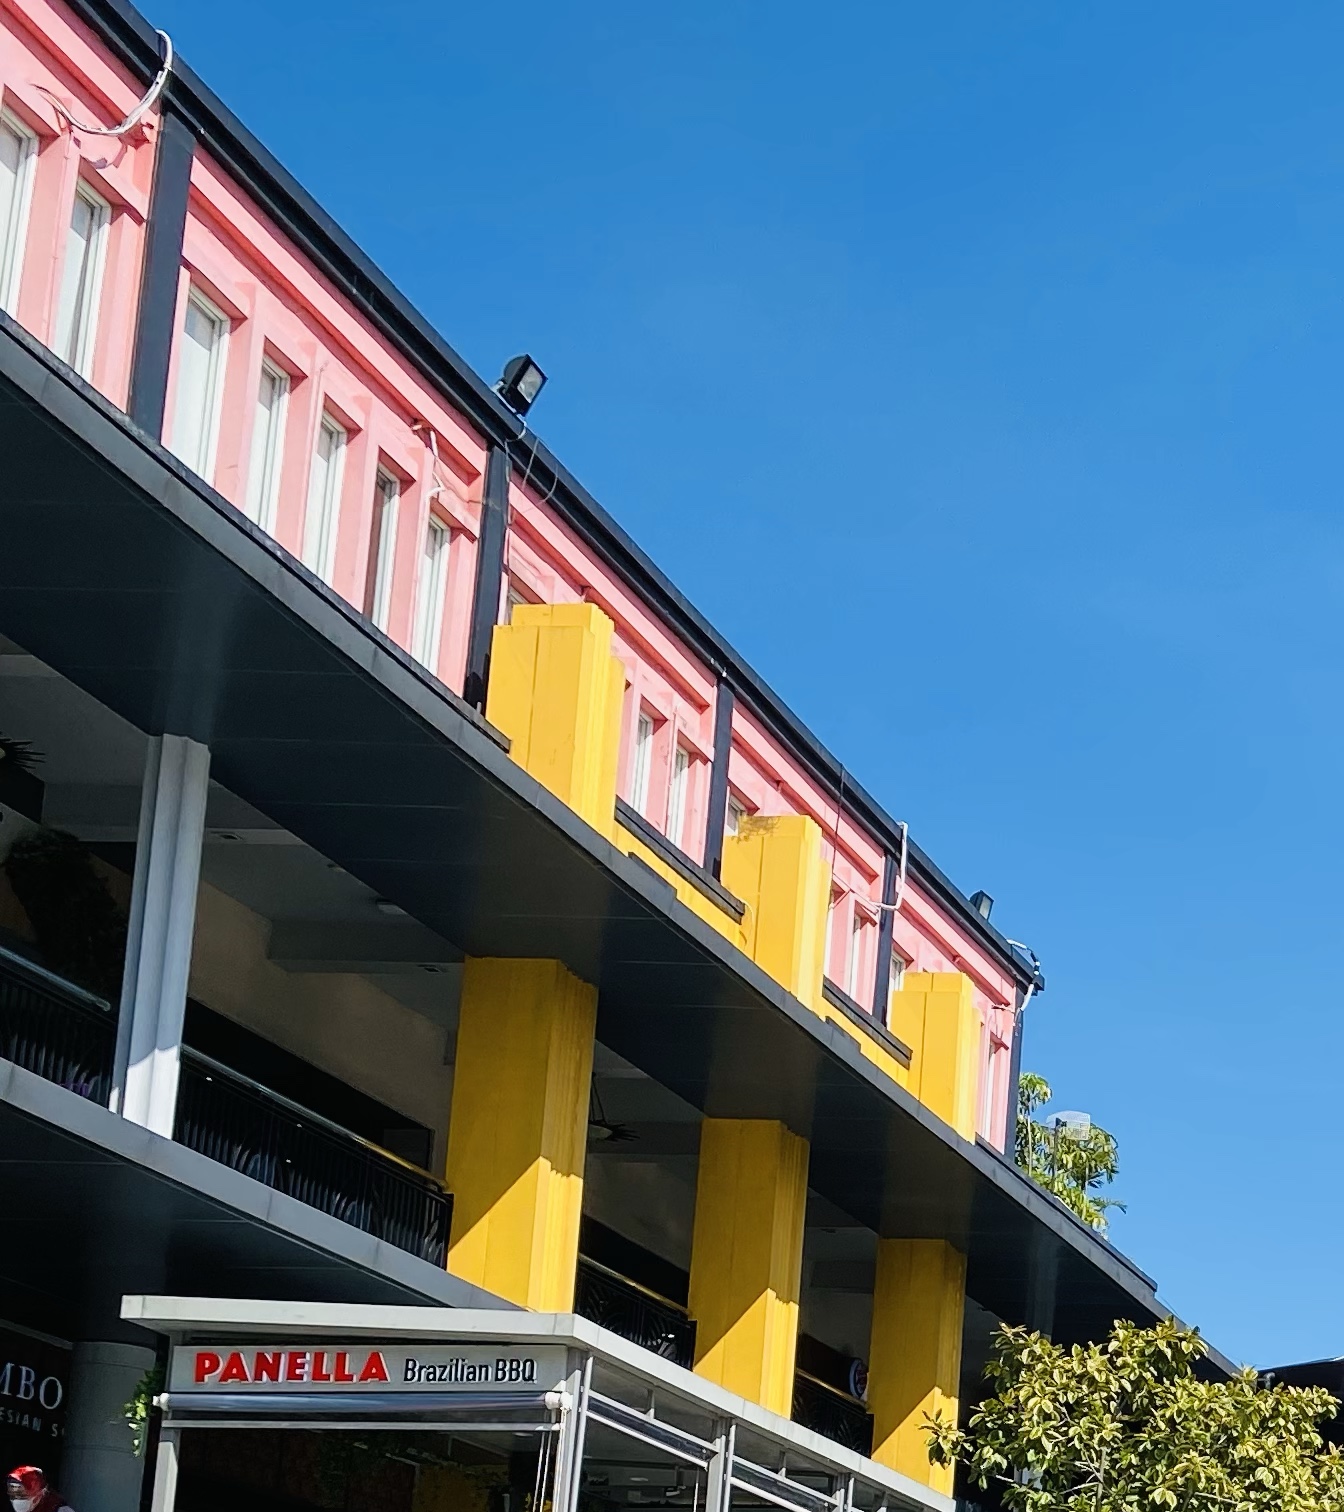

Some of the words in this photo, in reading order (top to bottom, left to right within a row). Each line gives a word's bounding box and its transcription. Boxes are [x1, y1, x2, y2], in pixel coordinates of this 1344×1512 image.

[194, 1351, 390, 1384] PANELLA
[403, 1357, 490, 1383] Brazilian
[494, 1358, 537, 1384] BBQ
